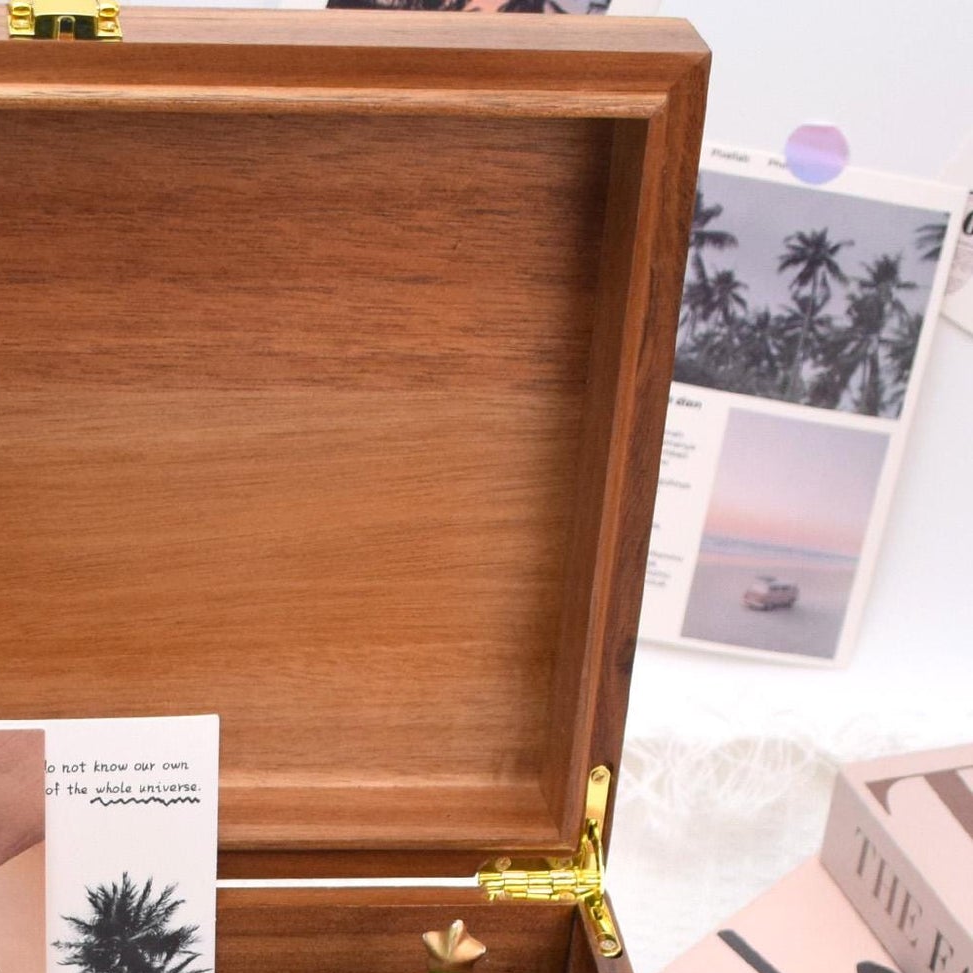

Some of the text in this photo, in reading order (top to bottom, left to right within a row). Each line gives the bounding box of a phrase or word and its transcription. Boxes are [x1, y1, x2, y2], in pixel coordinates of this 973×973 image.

[62, 761, 87, 773] not
[94, 761, 128, 772] know
[134, 762, 155, 771] our
[162, 761, 189, 770] own
[45, 782, 60, 795] of
[67, 782, 87, 795] the
[96, 781, 132, 795] whole
[855, 826, 923, 948] THE
